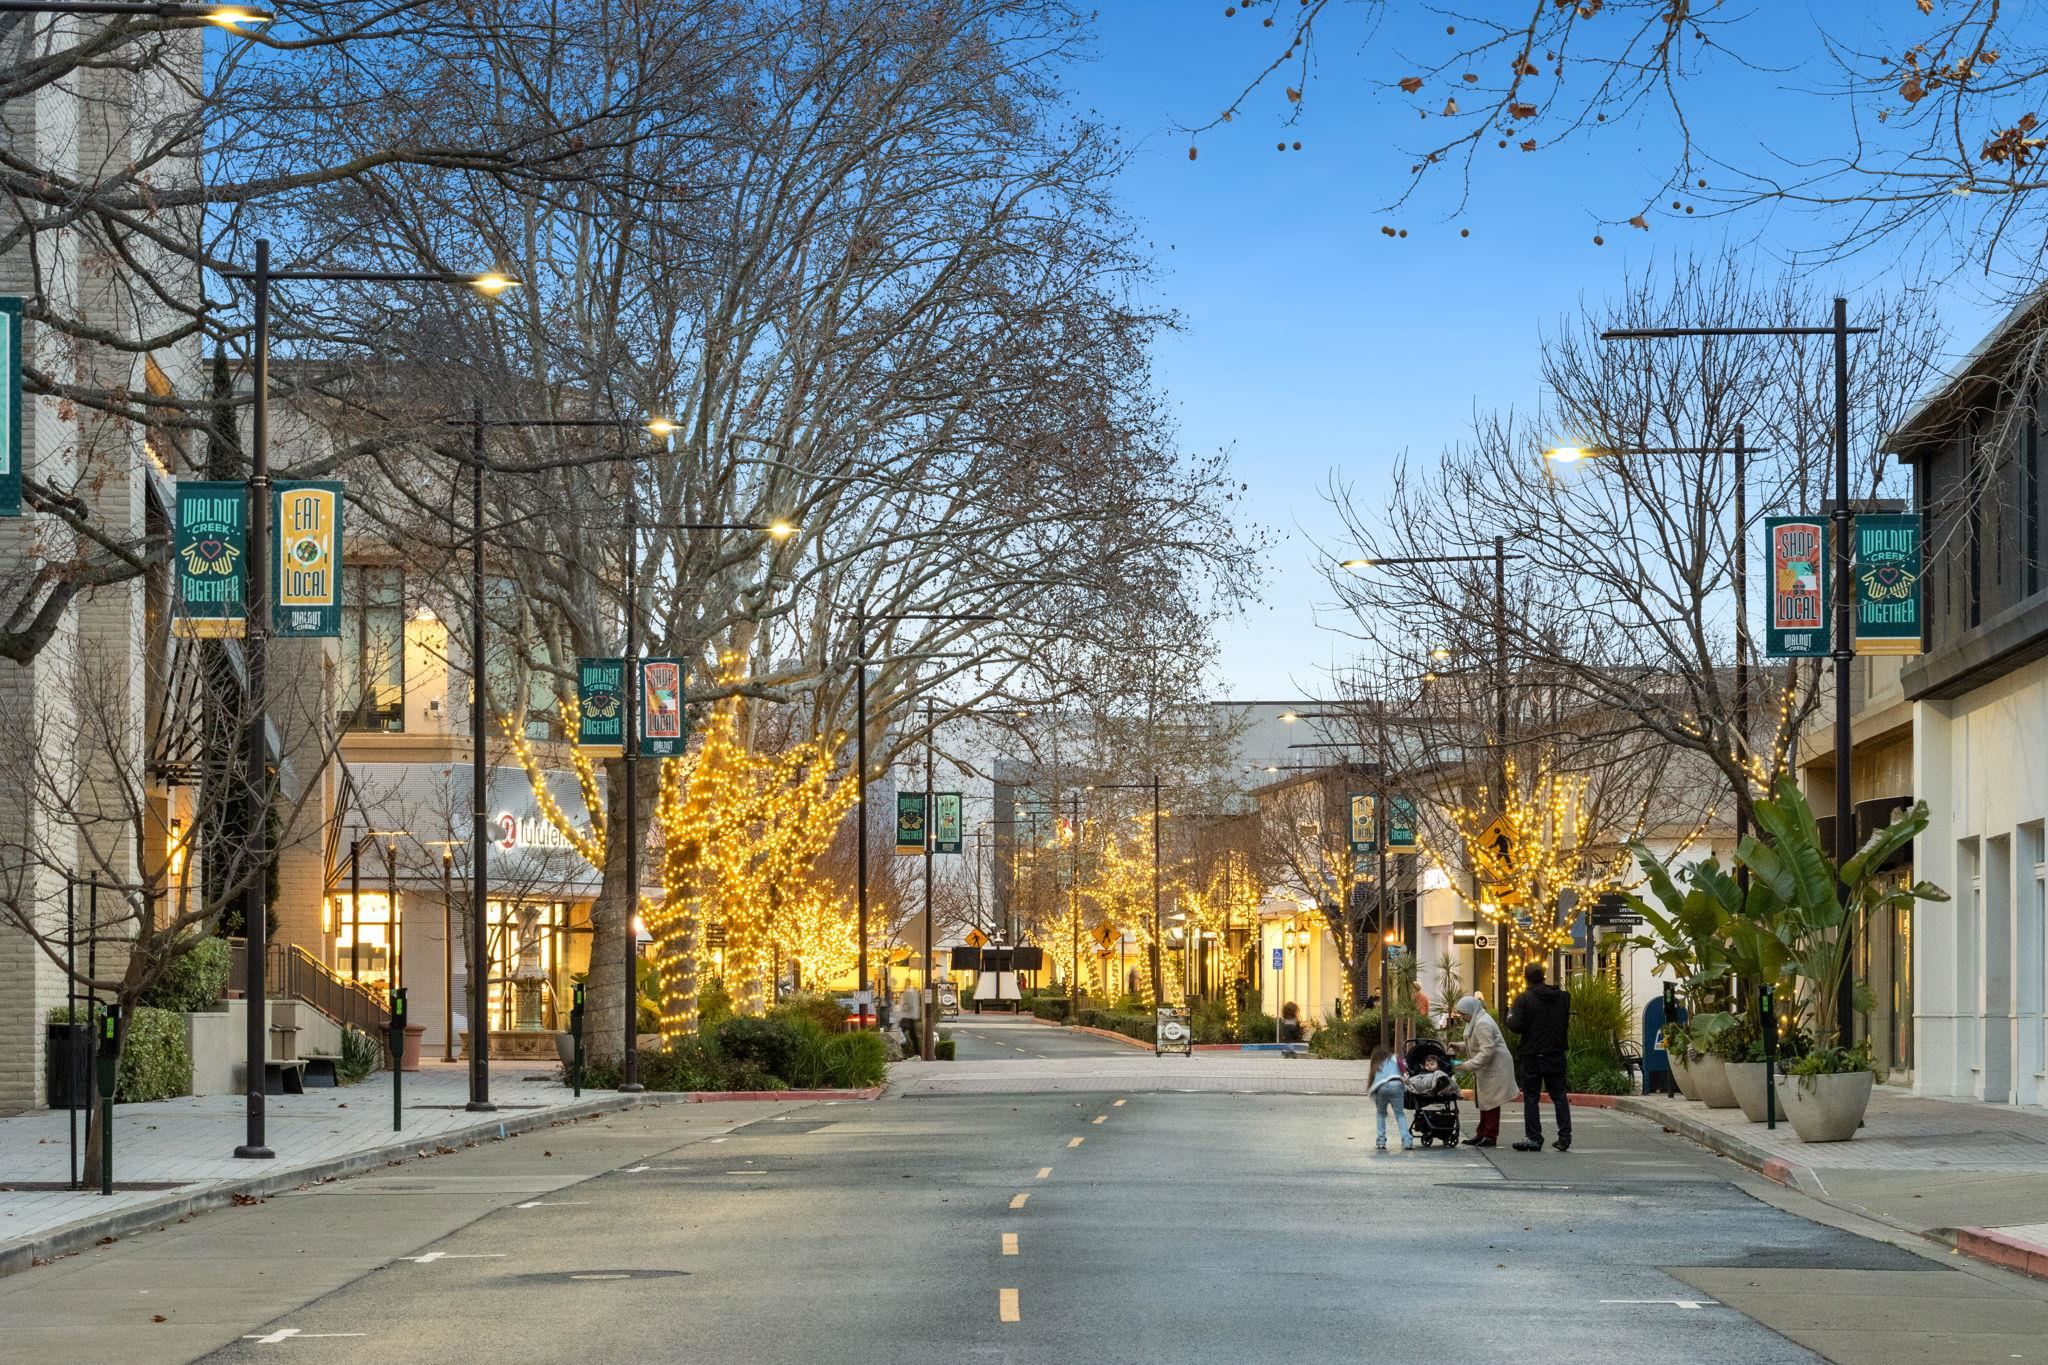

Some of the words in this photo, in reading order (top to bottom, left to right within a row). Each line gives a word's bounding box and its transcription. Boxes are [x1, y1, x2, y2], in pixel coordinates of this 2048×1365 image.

[183, 498, 240, 527] WALNUT
[294, 497, 321, 531] EAT
[192, 523, 230, 534] CREEK
[1781, 532, 1814, 558] SHOP
[1862, 529, 1914, 556] WALNUT
[1870, 552, 1906, 562] CREEK
[181, 574, 240, 602] TOGETHER
[286, 568, 328, 597] LOCAL
[1779, 593, 1818, 620] LOCAL
[1861, 598, 1915, 623] TOGETHER
[291, 611, 321, 627] WALNUT
[1784, 634, 1812, 648] WALNUT
[583, 668, 620, 687] WALNUT
[588, 684, 614, 692] CREEK
[650, 668, 674, 688] SHOP
[582, 717, 620, 735] TOGETHER
[649, 713, 676, 732] LOCAL
[521, 819, 588, 846] lululen
